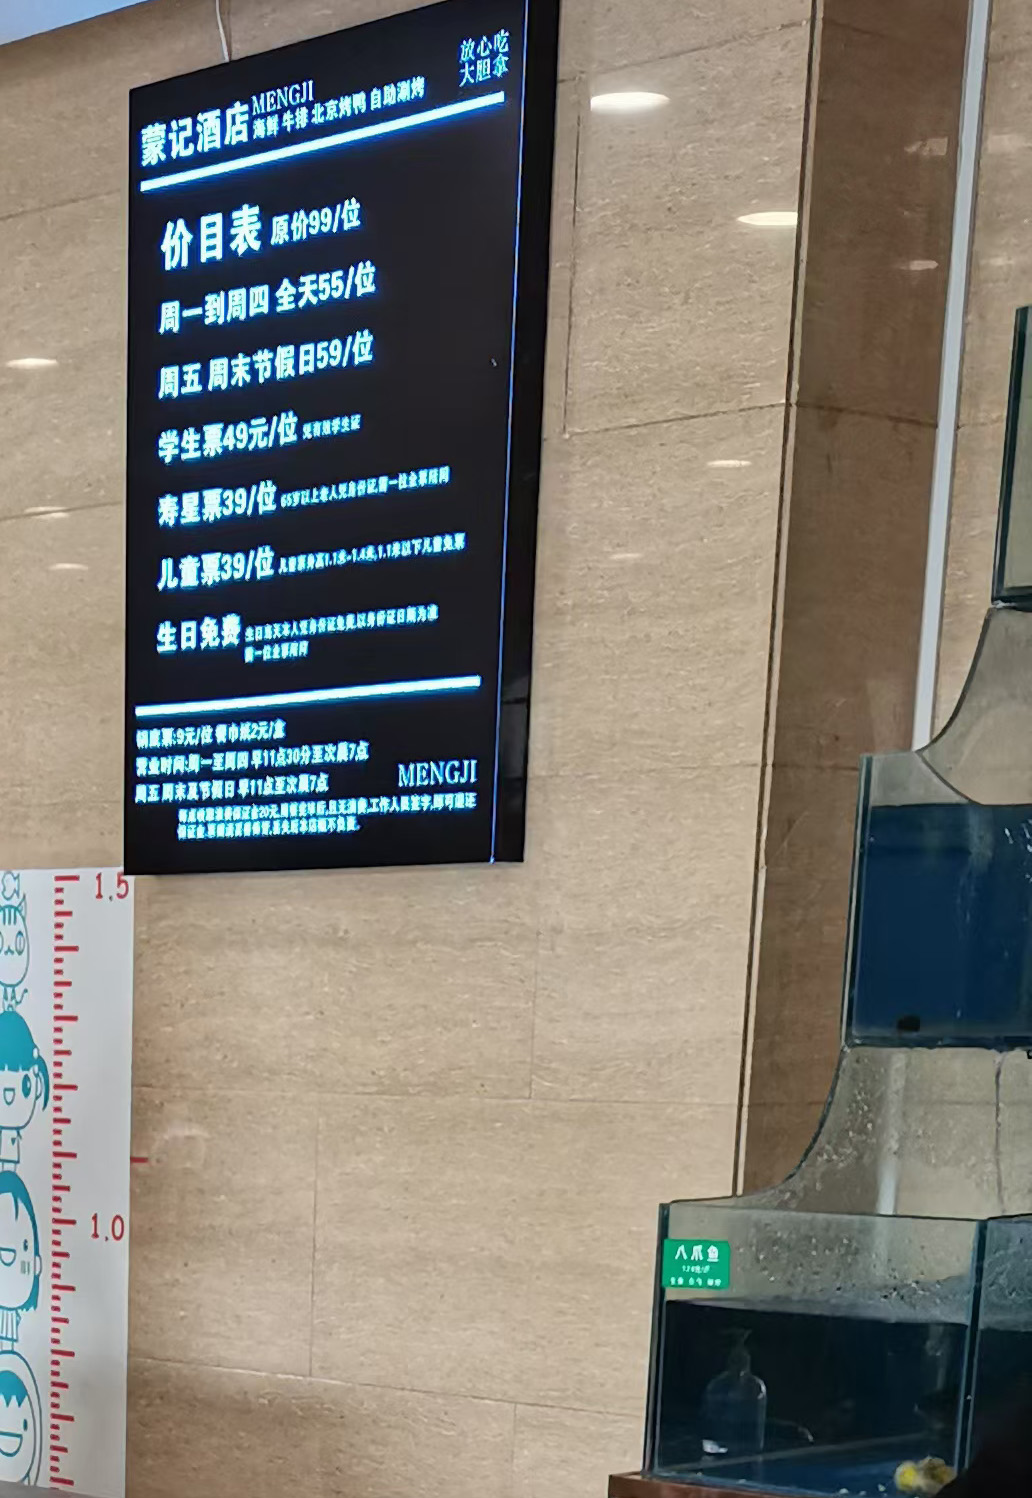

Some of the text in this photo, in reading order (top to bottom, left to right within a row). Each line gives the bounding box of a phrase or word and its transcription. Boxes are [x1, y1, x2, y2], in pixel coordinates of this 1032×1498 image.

[461, 29, 509, 62] 放心吃
[460, 56, 508, 86] 大胆拿
[252, 80, 313, 115] MENGJI
[253, 114, 278, 139] 海鲜
[283, 107, 308, 132] 牛排
[312, 92, 366, 123] 北京烤鸭
[142, 101, 248, 166] 蒙记酒店
[161, 197, 360, 270] 价目表 原价99/位
[159, 261, 375, 334] 周一到周四 全天55/位
[159, 330, 373, 398] 周五 周末节假日59/位
[159, 412, 297, 463] 学生票49元/位
[159, 480, 276, 526] 寿星票39/位
[157, 546, 274, 590] 儿童票39/位
[157, 614, 240, 653] 生日免费
[135, 784, 158, 803] 周五
[399, 761, 476, 787] MENGJI
[94, 872, 129, 902] 1.5
[90, 1213, 125, 1241] 1.0
[675, 1244, 719, 1262] 八爪鱼
